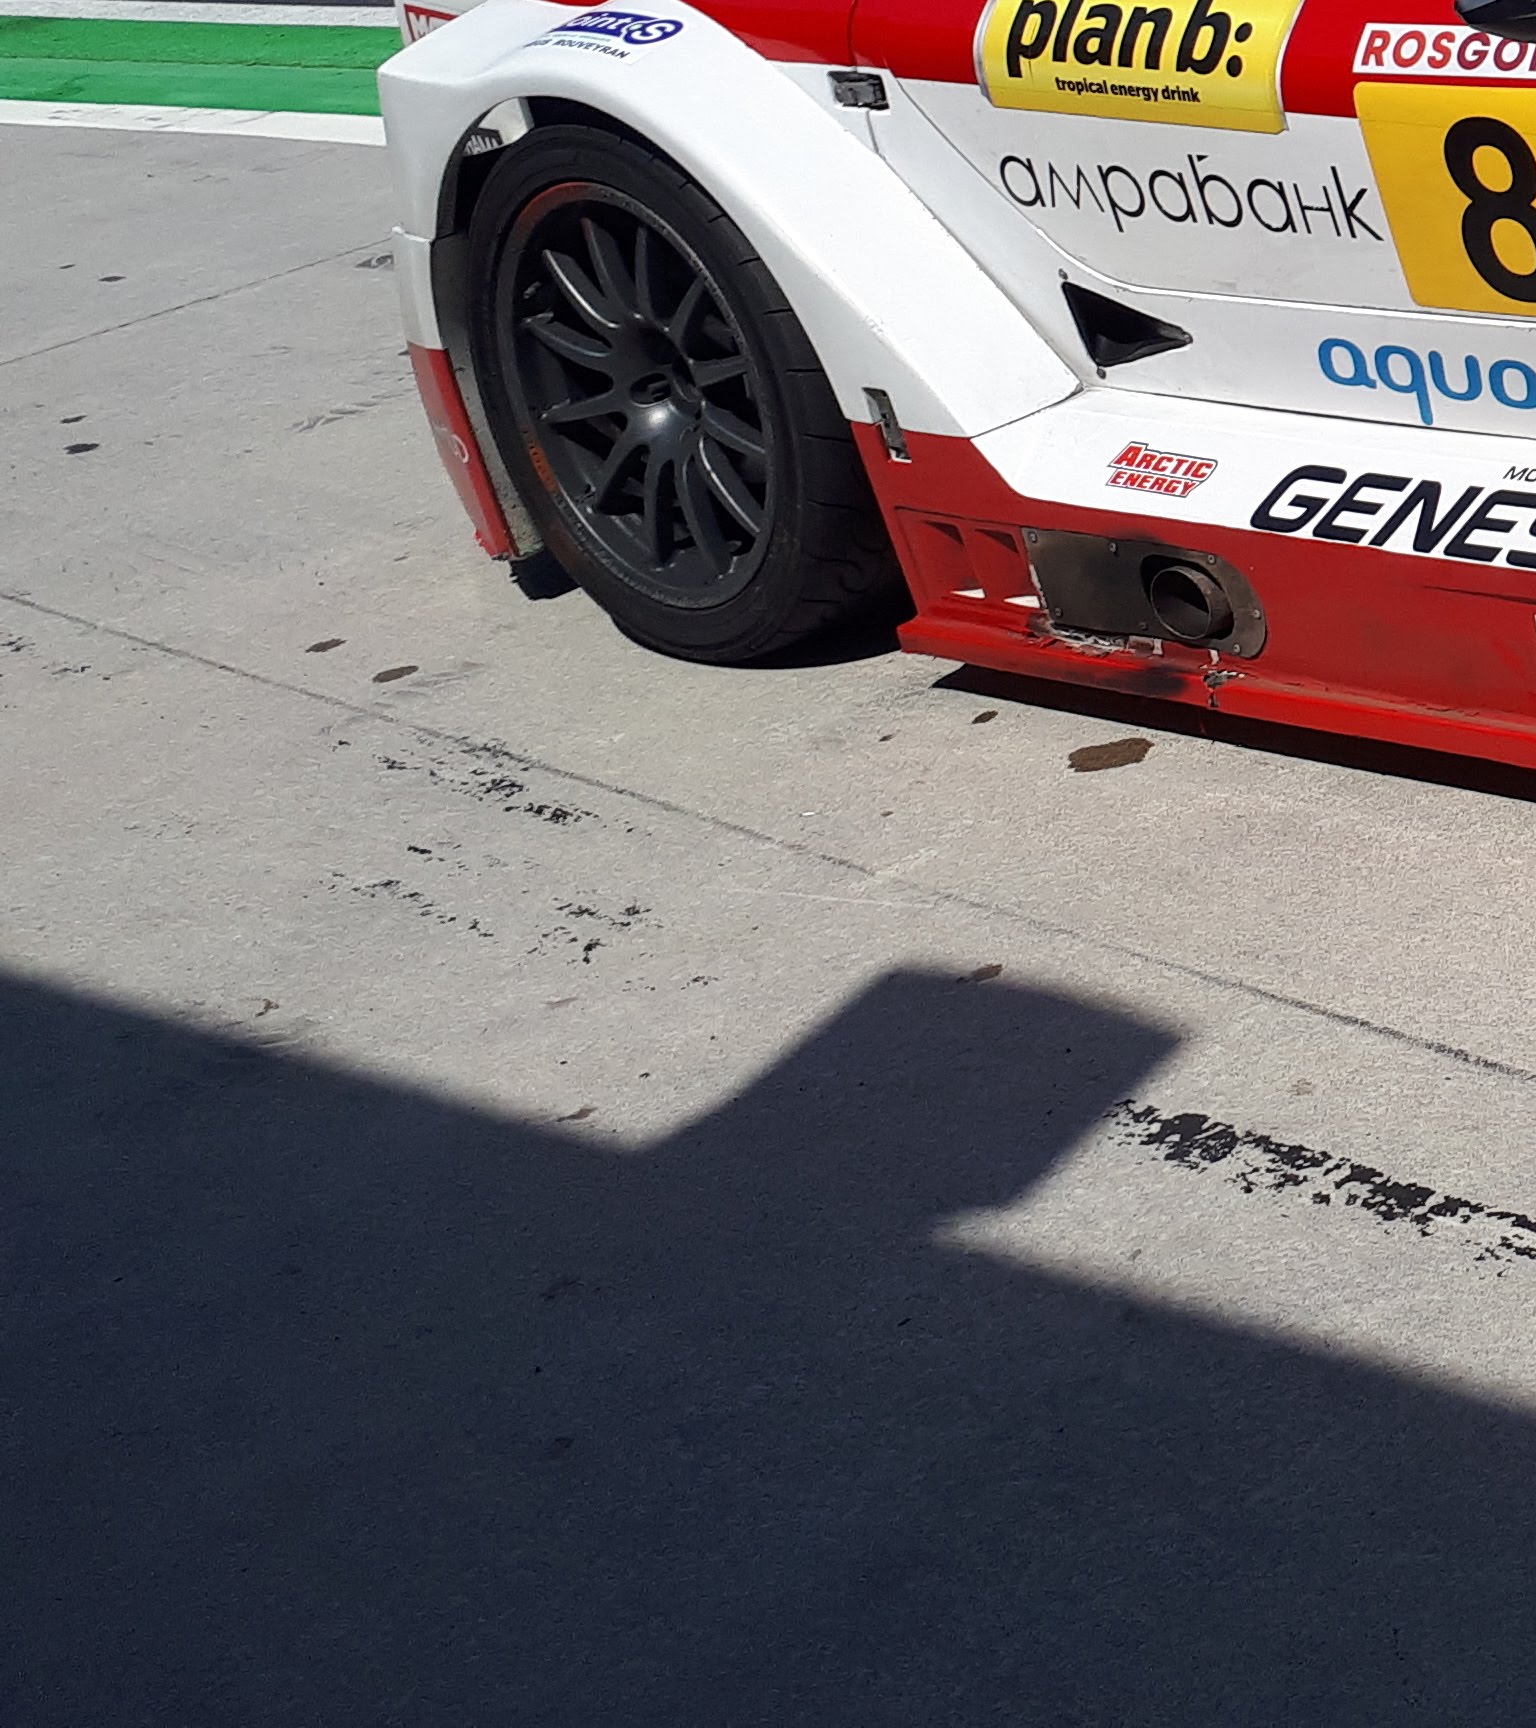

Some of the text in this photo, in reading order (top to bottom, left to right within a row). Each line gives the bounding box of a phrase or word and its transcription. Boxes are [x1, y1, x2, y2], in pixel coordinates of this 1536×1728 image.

[1055, 77, 1201, 103] tropical energy drink
[1112, 445, 1214, 478] ARCTIC
[1109, 470, 1197, 495] ENERGY
